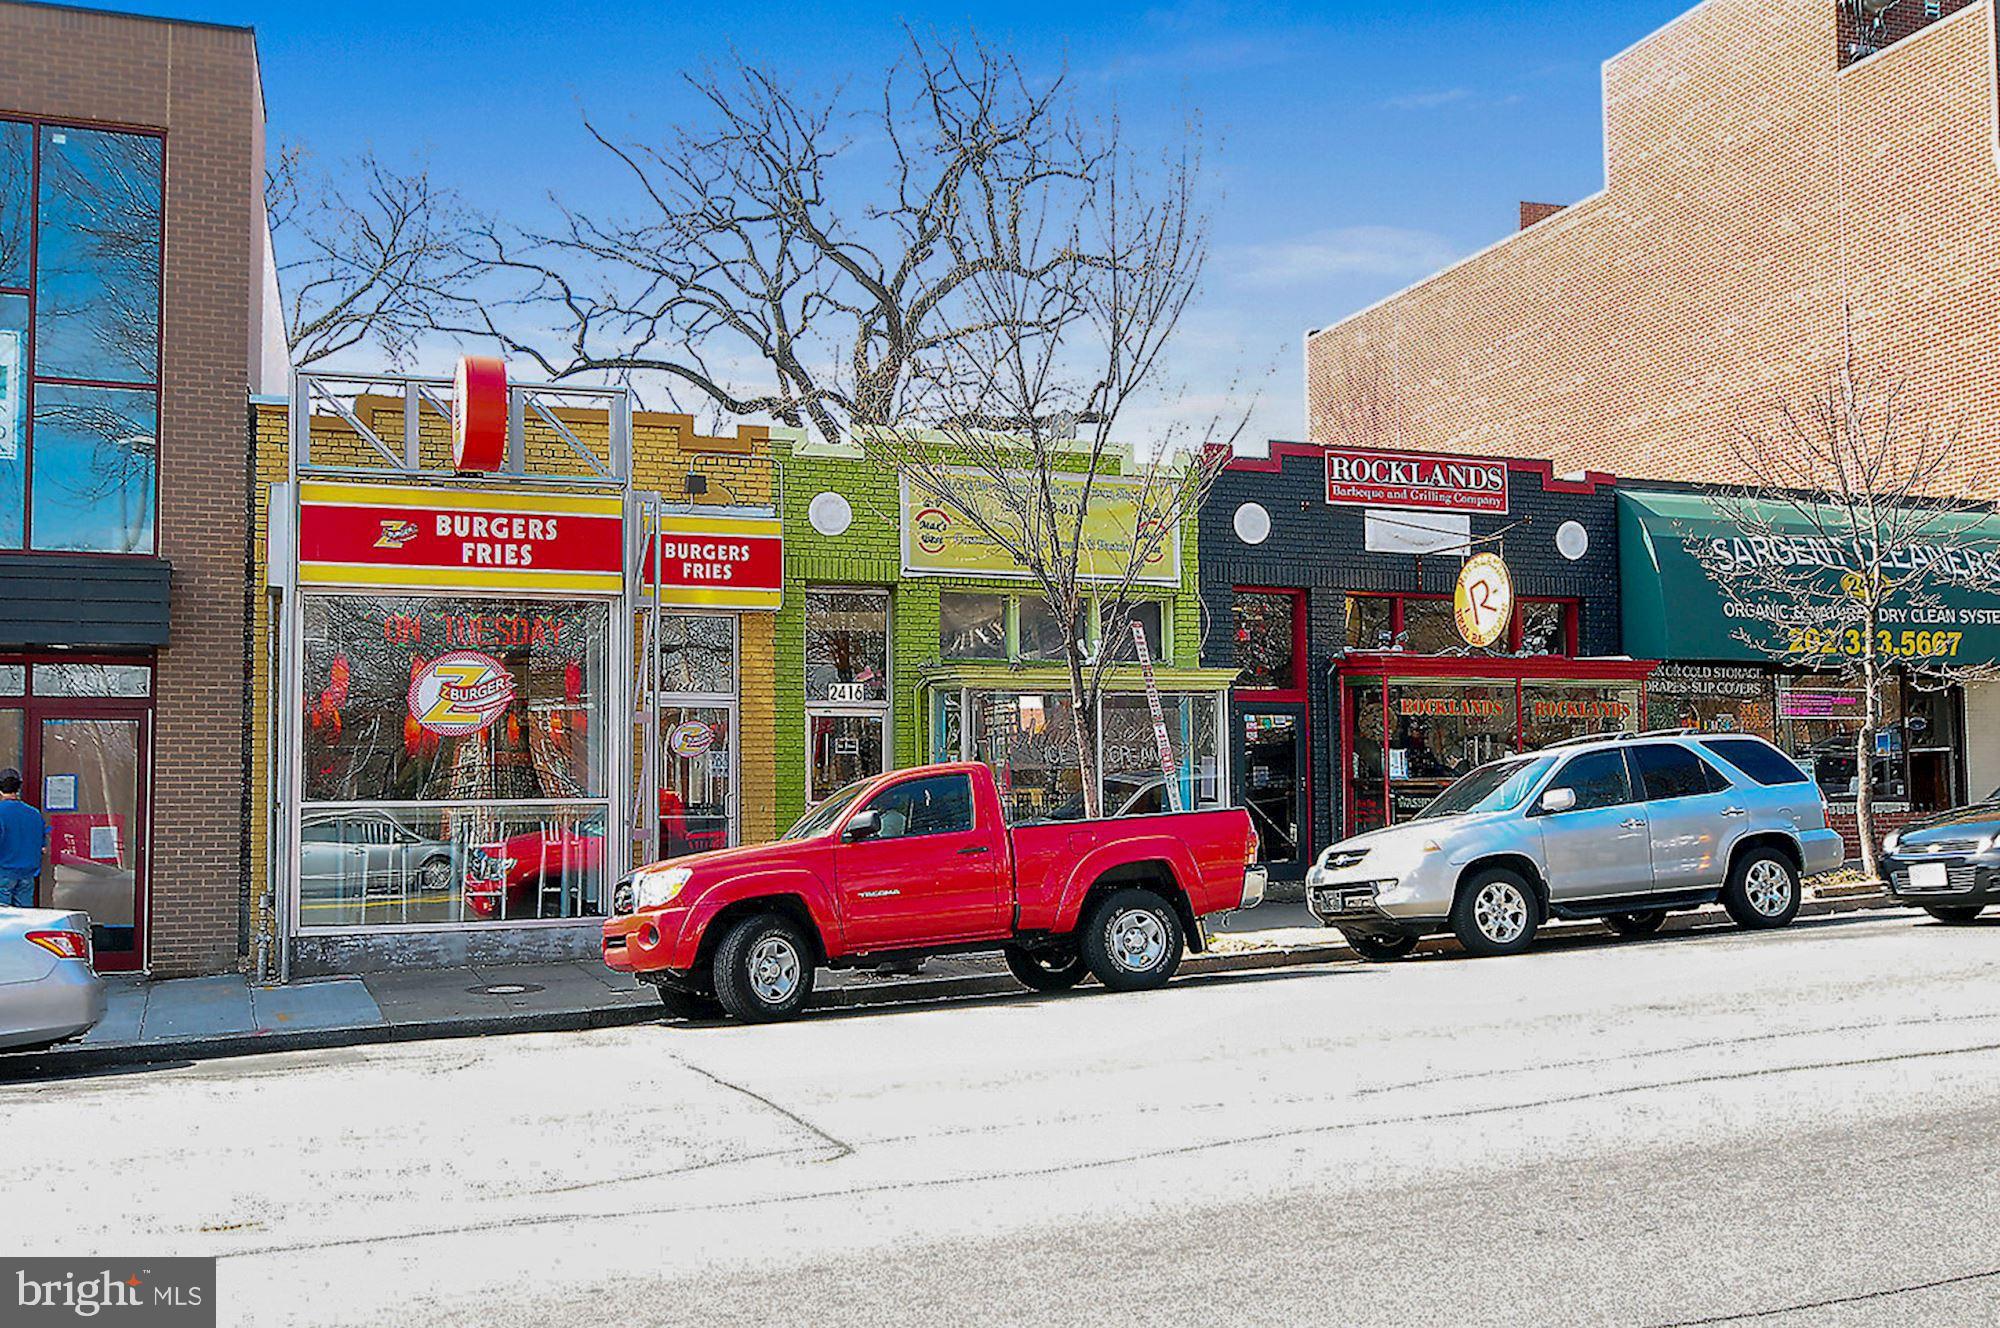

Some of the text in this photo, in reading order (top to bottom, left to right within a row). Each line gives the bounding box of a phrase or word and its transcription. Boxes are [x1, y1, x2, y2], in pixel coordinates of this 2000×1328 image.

[1330, 456, 1504, 491] ROCKLANDS
[1332, 484, 1503, 507] Barbeque and Grilling Company
[436, 514, 557, 541] BURGERS
[462, 542, 534, 567] FRIES
[665, 542, 751, 562] BURGERS
[1711, 536, 1848, 571] SARGENT
[683, 562, 733, 581] FRIES
[1723, 602, 1789, 619] ORGANIC
[1879, 608, 1907, 623] DRY
[1910, 608, 1956, 624] CLEAN
[438, 614, 564, 646] TUESDAY
[1788, 627, 1963, 657] 202.33.5667
[1682, 665, 1711, 679] COLD
[1713, 667, 1763, 680] STORAGE
[829, 685, 863, 701] 2416
[1716, 682, 1761, 695] COVERS
[1401, 699, 1503, 716] ROCKLANDS
[1535, 701, 1631, 718] ROCKLANDS
